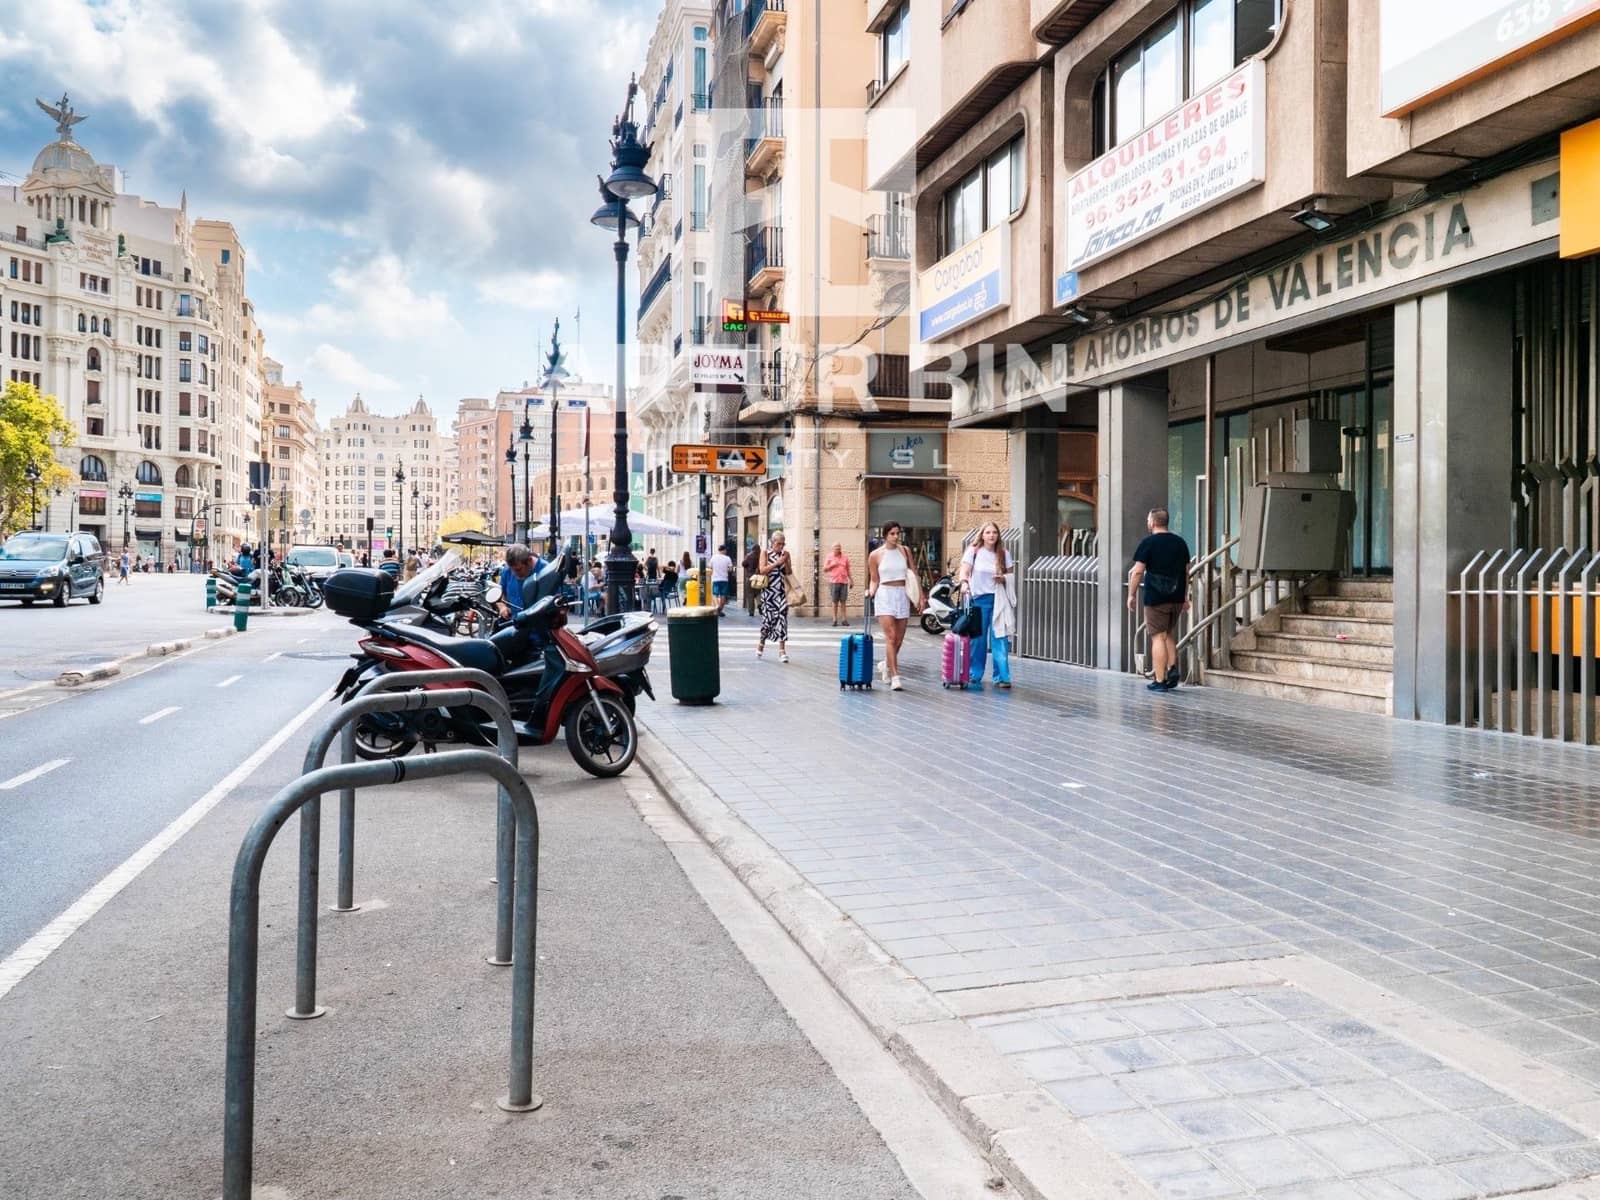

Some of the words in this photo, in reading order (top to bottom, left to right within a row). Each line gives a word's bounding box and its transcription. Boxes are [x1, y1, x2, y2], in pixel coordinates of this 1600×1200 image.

[1072, 74, 1246, 198] ALQUILERES
[1183, 126, 1208, 148] PLAZAS
[1209, 120, 1219, 136] DE
[1220, 102, 1248, 131] GARAJE
[1085, 136, 1228, 230] 96.352.31.94
[934, 241, 984, 291] Cargobot
[1053, 345, 1075, 381] DE
[1084, 310, 1199, 371] AHORROS
[1214, 292, 1249, 329] DE
[1268, 203, 1475, 312] VALENCIA
[694, 354, 743, 369] JOYMA
